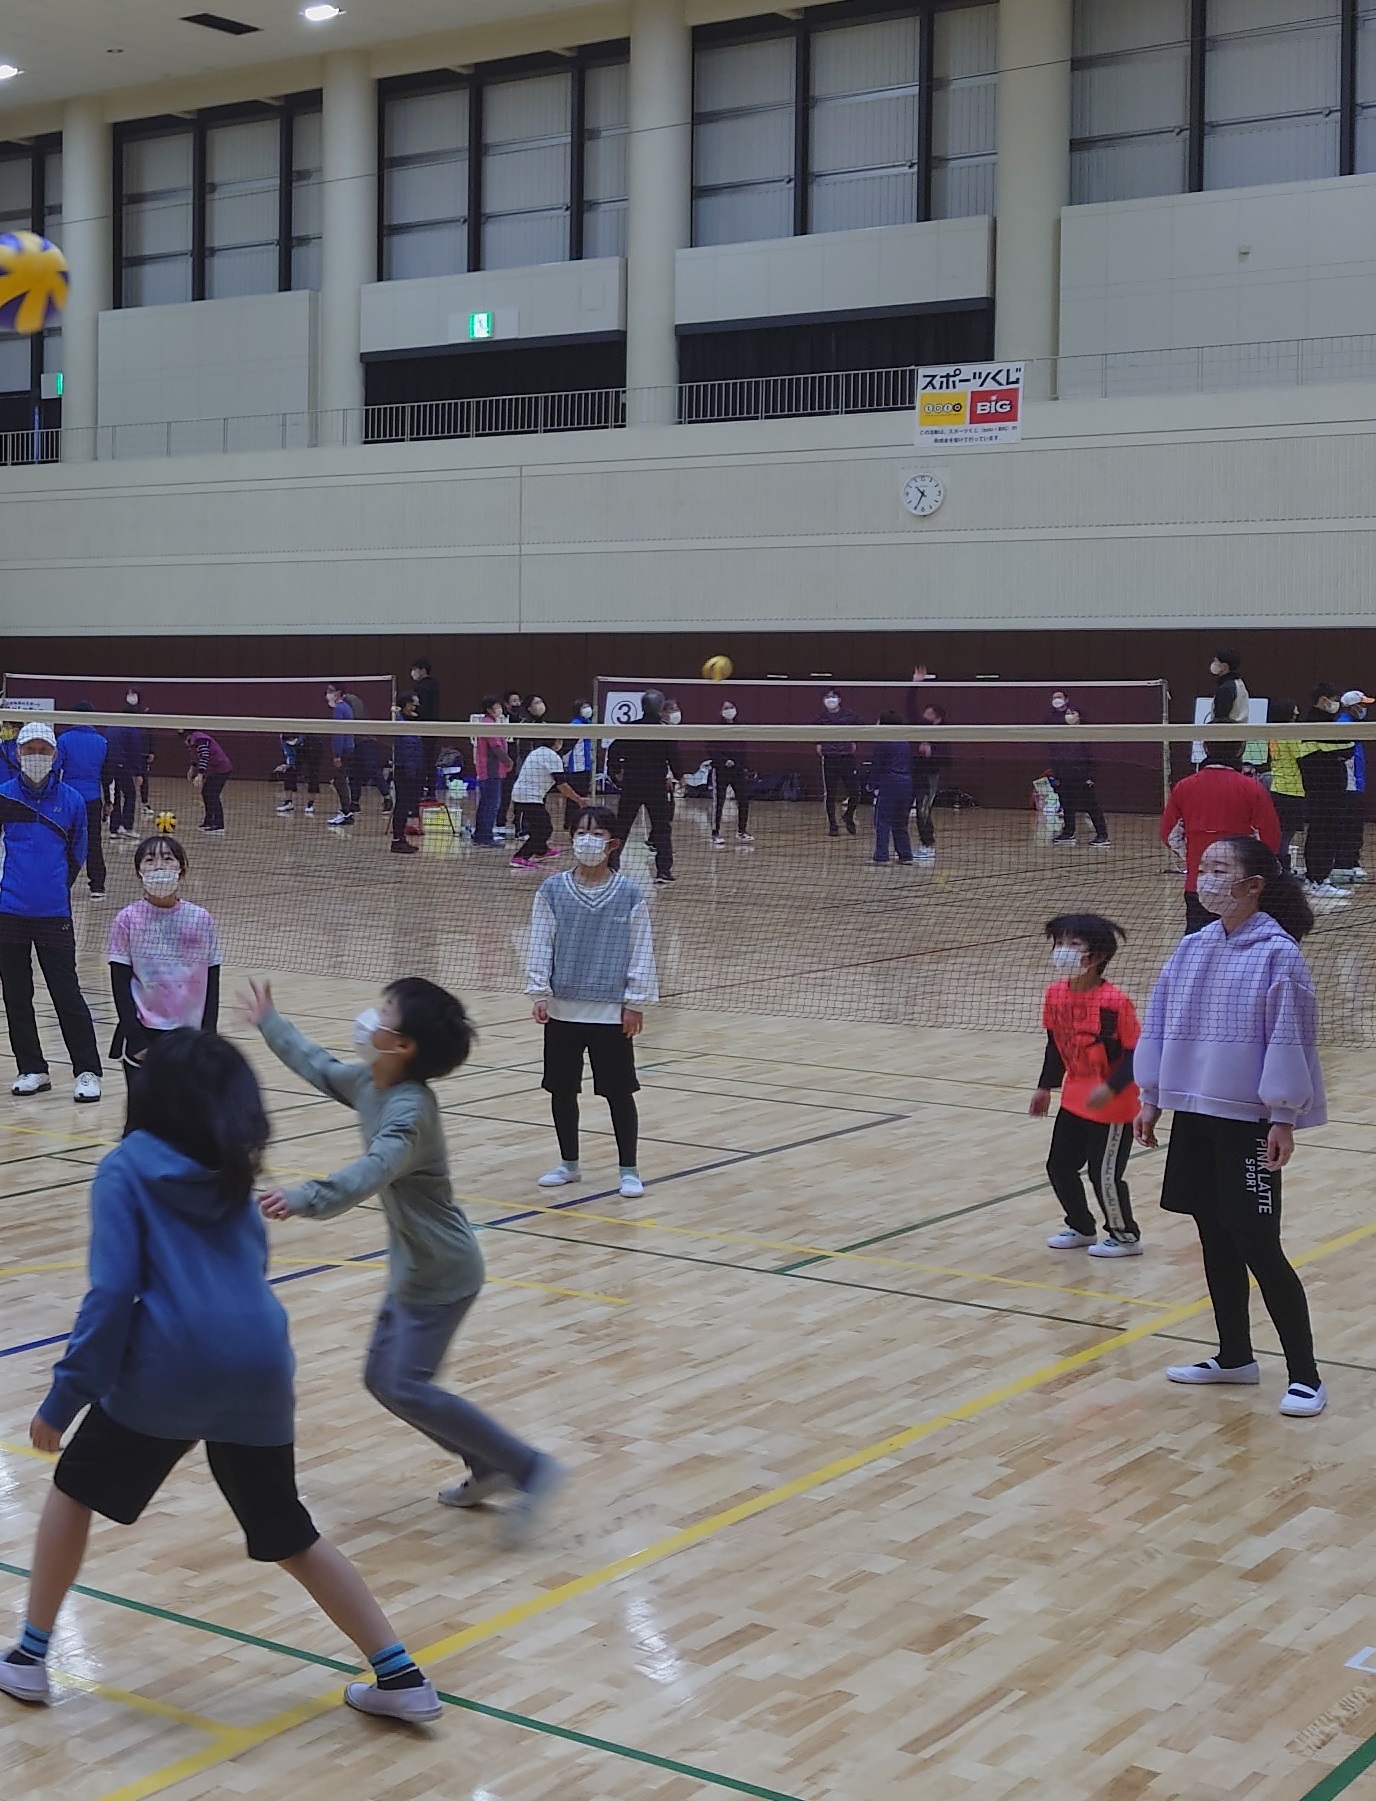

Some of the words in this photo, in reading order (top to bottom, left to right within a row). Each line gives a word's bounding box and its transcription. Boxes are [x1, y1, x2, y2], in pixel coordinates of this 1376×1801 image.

[922, 367, 1022, 390] スポーツくじ
[976, 400, 1012, 414] BIG
[1245, 1157, 1257, 1193] SPORT
[1257, 1173, 1273, 1214] LATTE
